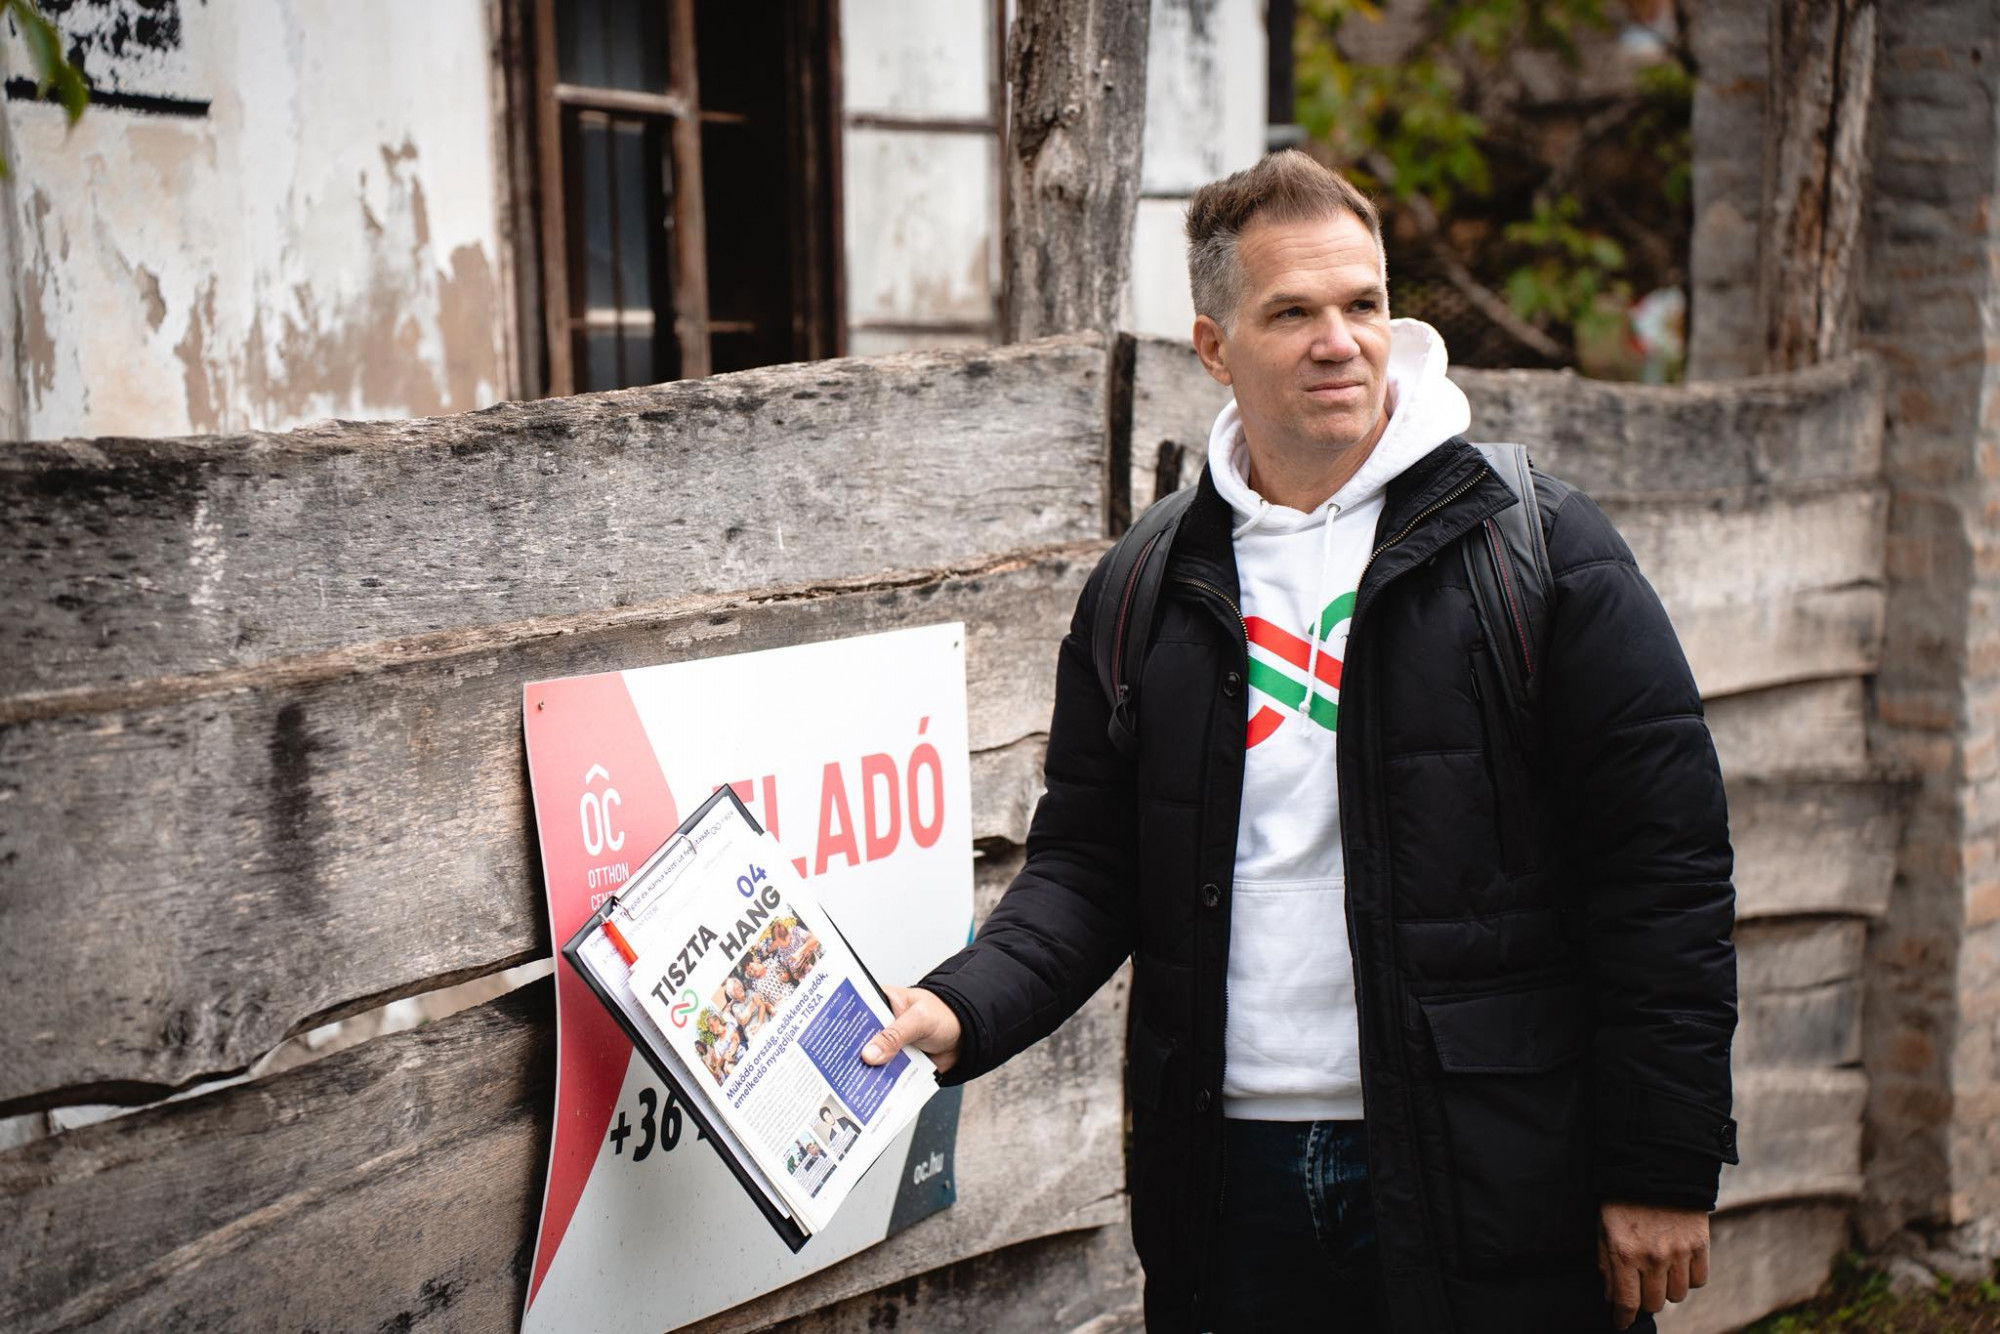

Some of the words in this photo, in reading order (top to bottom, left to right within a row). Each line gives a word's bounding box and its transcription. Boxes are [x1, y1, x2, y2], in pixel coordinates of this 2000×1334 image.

[588, 862, 630, 889] OTTHON
[737, 864, 767, 898] 04
[719, 885, 781, 962] HANG
[651, 925, 718, 1007] TISZTA
[754, 1034, 779, 1066] ország,
[809, 971, 829, 997] adók,
[800, 993, 824, 1020] TISZA
[610, 1087, 683, 1162] +36
